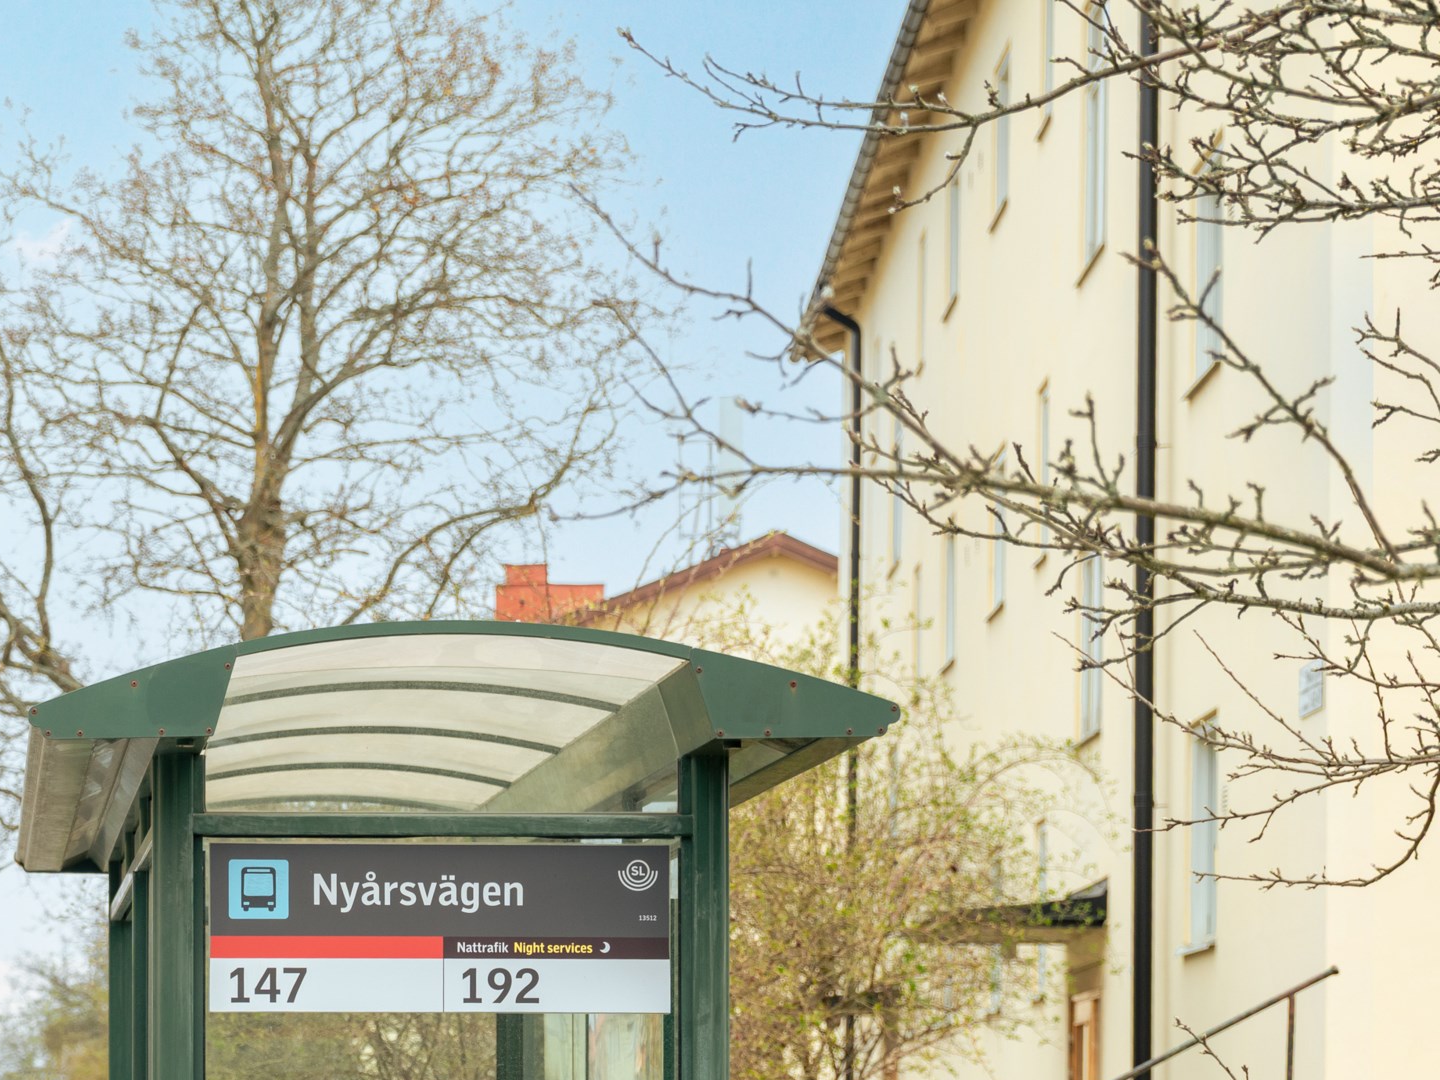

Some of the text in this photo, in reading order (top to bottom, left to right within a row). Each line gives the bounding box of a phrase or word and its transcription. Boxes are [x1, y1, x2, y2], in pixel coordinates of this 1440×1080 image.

[312, 871, 524, 914] Nyårsvägen
[638, 914, 657, 922] 13512
[456, 941, 593, 955] Nattrafik Night services
[229, 967, 308, 1004] 147
[462, 967, 540, 1004] 192
